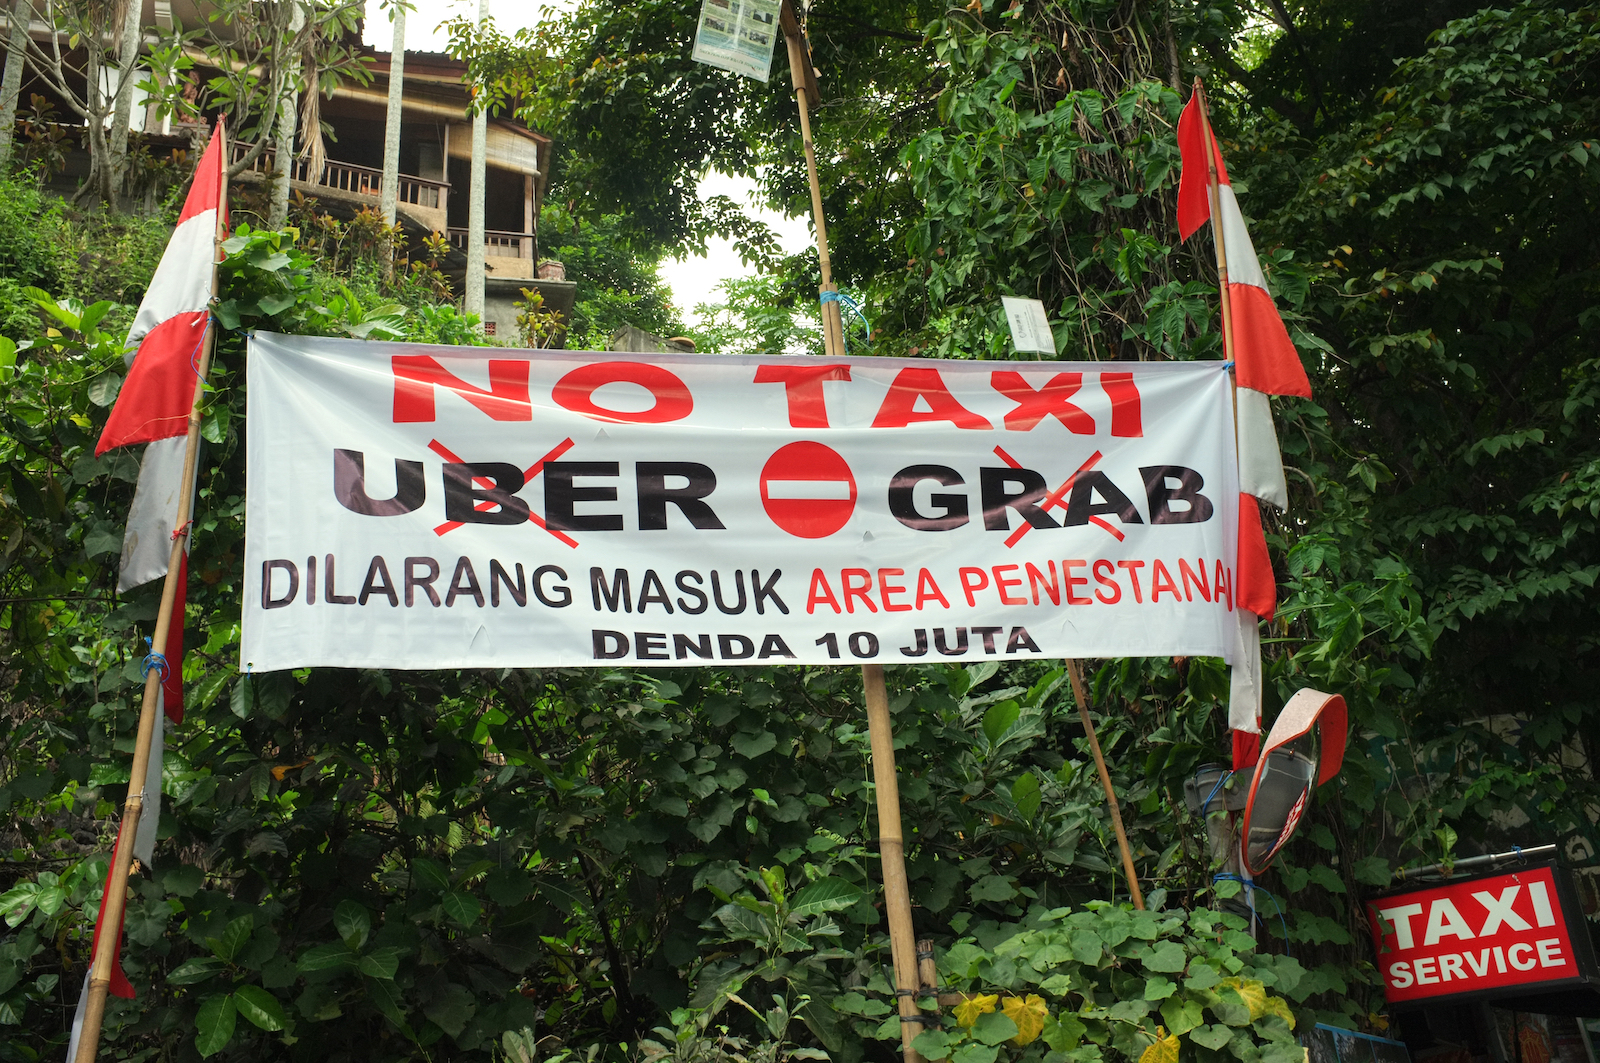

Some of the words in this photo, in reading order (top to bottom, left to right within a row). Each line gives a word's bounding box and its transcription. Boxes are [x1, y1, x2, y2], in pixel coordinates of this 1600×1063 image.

[392, 355, 694, 423] NO
[753, 364, 1144, 438] TAXI
[333, 448, 727, 531] UBER
[888, 463, 1214, 532] GRAB
[261, 553, 573, 609] DILARANG
[590, 567, 790, 614] MASUK
[807, 567, 950, 615] AREA
[592, 629, 797, 661] DENDA
[814, 632, 880, 659] 10
[900, 626, 1043, 657] JUTA
[1380, 880, 1556, 951] TAXI
[1389, 938, 1566, 989] SERVICE
